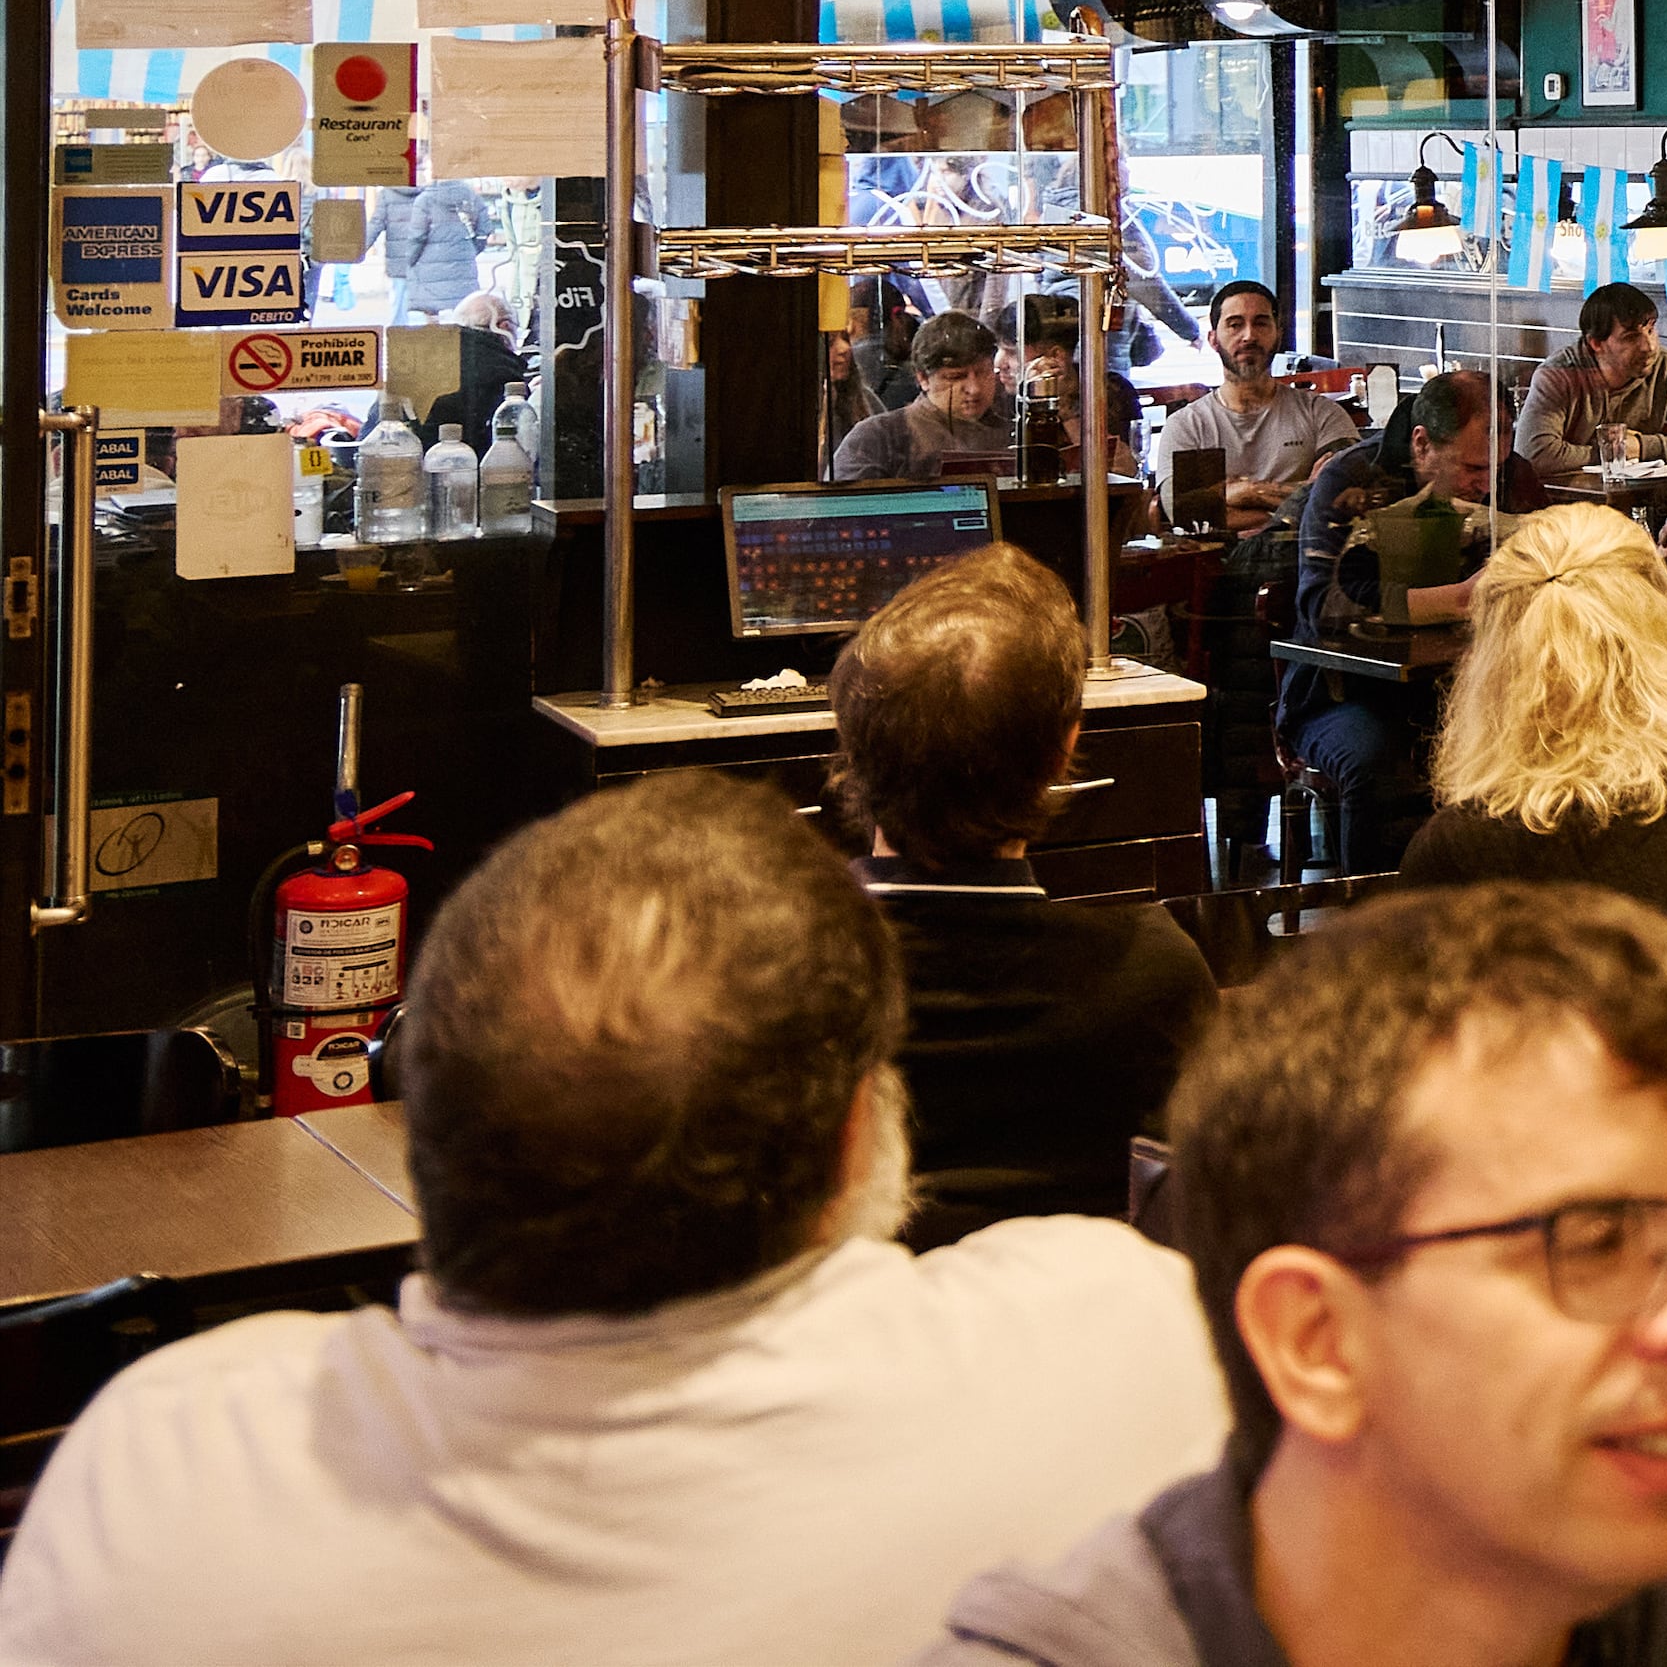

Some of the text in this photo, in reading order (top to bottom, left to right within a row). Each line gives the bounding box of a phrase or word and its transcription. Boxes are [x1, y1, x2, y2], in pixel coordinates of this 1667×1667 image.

[320, 118, 403, 131] Restaurant
[188, 191, 295, 224] VISA
[64, 225, 158, 242] AMERICAN
[81, 242, 163, 259] EXPRESS
[187, 265, 294, 298] VISA
[66, 288, 120, 301] Cards
[66, 304, 152, 316] Welcome
[250, 311, 295, 323] DEBITO
[301, 338, 366, 349] Prohibido
[301, 350, 365, 368] FUMAR
